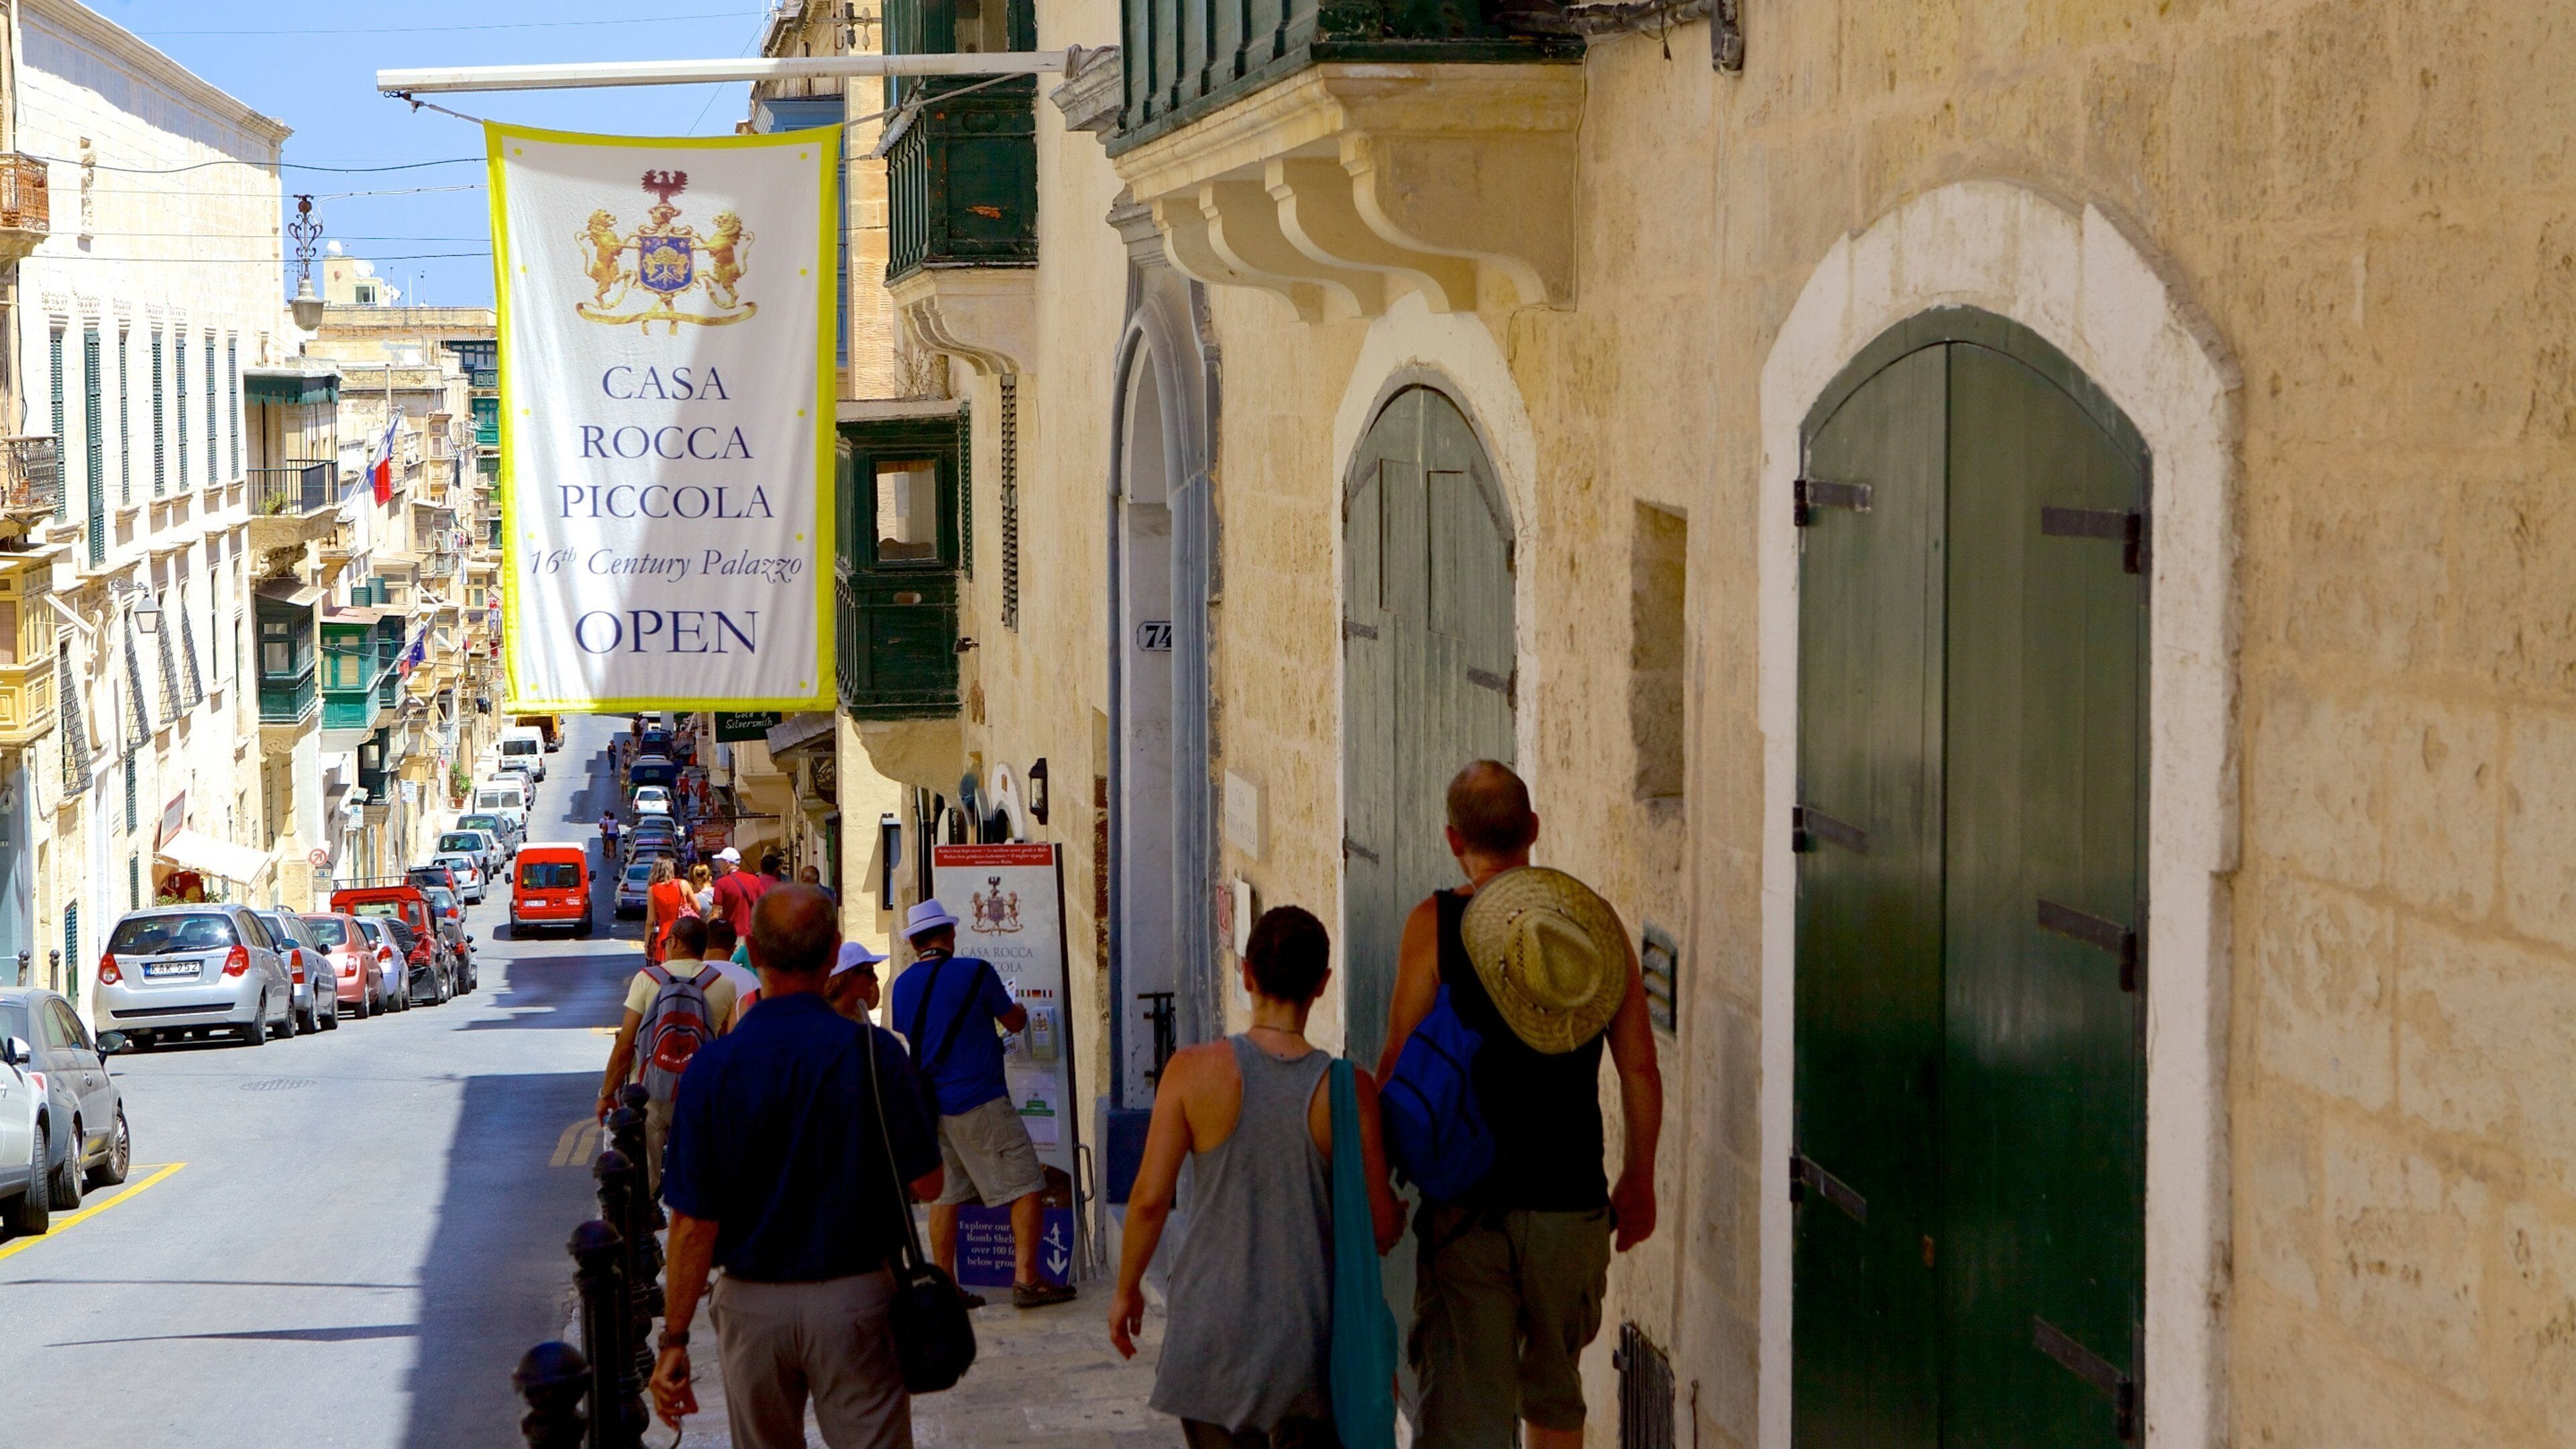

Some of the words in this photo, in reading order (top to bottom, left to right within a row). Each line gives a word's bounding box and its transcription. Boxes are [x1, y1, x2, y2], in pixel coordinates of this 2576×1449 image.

[602, 366, 731, 401] CASA
[579, 425, 753, 460] ROCCA
[557, 484, 774, 519] PICCOLA
[588, 549, 690, 583] Century
[700, 549, 802, 584] Palazzo
[575, 610, 759, 655] OPEN
[1146, 625, 1171, 648] 74
[725, 716, 773, 729] Silversmith
[961, 947, 989, 958] CASA
[993, 947, 1032, 958] ROCCA
[151, 963, 172, 973] KAK
[176, 962, 197, 972] 952
[993, 962, 1022, 973] COLA
[959, 1221, 993, 1233] Explore
[967, 1233, 993, 1242] Bomb
[994, 1234, 1015, 1244] Shelt
[993, 1246, 1007, 1255] 100
[967, 1256, 992, 1266] below
[995, 1260, 1016, 1271] grou
